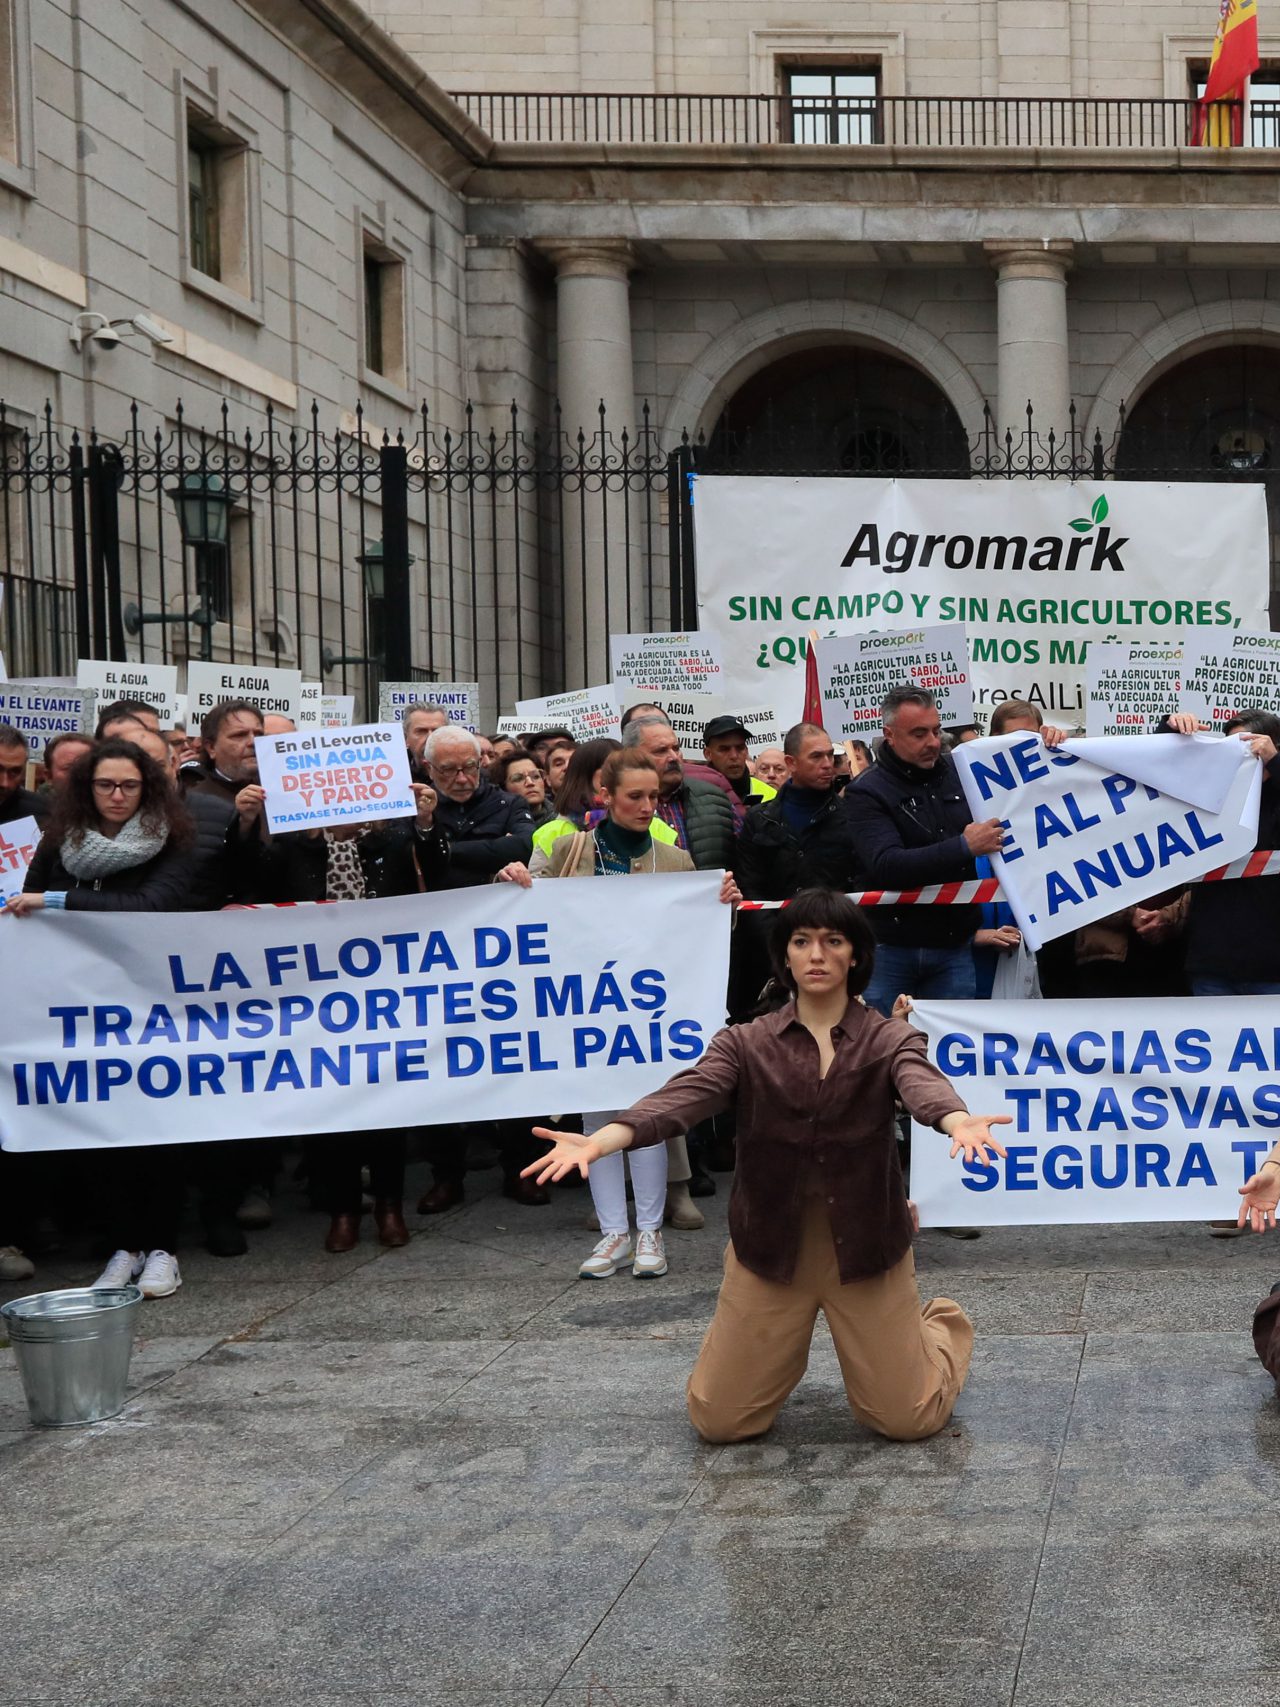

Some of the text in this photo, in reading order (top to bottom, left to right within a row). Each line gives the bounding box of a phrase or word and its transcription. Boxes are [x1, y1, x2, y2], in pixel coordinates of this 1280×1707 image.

[840, 523, 1129, 574] Agromark
[728, 590, 1241, 630] SIN CAMPO Y SIN AGRICULTORES,
[860, 632, 925, 651] proexport
[638, 651, 687, 659] AGRICULTURA
[854, 651, 953, 672] AGRICULTURA ES LA
[634, 668, 673, 676] ADECUADA
[686, 665, 719, 674] SENCILLO
[889, 669, 907, 679] DEL
[910, 664, 943, 678] SABIO,
[946, 662, 958, 673] LA
[1121, 670, 1180, 679] AGRICULTUR
[1195, 668, 1258, 683] PROFESIÓN
[1259, 674, 1278, 685] DEL
[106, 673, 148, 685] EL AGUA
[222, 676, 269, 691] EL AGUA
[683, 682, 702, 690] TODO
[920, 673, 966, 688] SENCILLO
[1154, 682, 1171, 690] DEL
[1186, 678, 1208, 692] MÁS
[1212, 683, 1270, 697] ADECUADA
[9, 696, 23, 709] EL
[28, 697, 81, 712] LEVANTE
[102, 690, 165, 703] UN DERECHO
[199, 694, 213, 706] ES
[393, 694, 467, 704] EN LEVANTE
[844, 697, 866, 709] Y LA
[1114, 692, 1164, 702] ADECUADA
[1168, 693, 1179, 702] AL
[1205, 695, 1211, 705] Y
[1216, 696, 1229, 707] LA
[601, 702, 610, 710] LA
[667, 703, 694, 715] AGUA
[1108, 704, 1129, 713] Y LA
[15, 716, 78, 731] TRASVASE
[500, 723, 526, 731] MENOS
[589, 716, 619, 728] SENCILLO
[842, 720, 883, 734] HOMBRE
[1116, 715, 1145, 724] DIGNA
[1104, 726, 1142, 735] HOMBRE
[275, 731, 392, 754] En el Levante
[285, 746, 387, 770] SIN AGUA
[281, 763, 394, 793] DESIERTO
[299, 782, 388, 807] Y PARO
[272, 800, 412, 824] TRASVASE TAJO-SEGURA
[1034, 792, 1101, 849] AL
[1046, 810, 1224, 916] ANUAL
[167, 922, 551, 995] LA FLOTA DE
[49, 959, 668, 1050] TRANSPORTES MÁS
[12, 1010, 704, 1107] IMPORTANTE DEL PAÍS
[935, 1027, 1213, 1078] GRACIAS
[961, 1142, 1218, 1192] SEGURA
